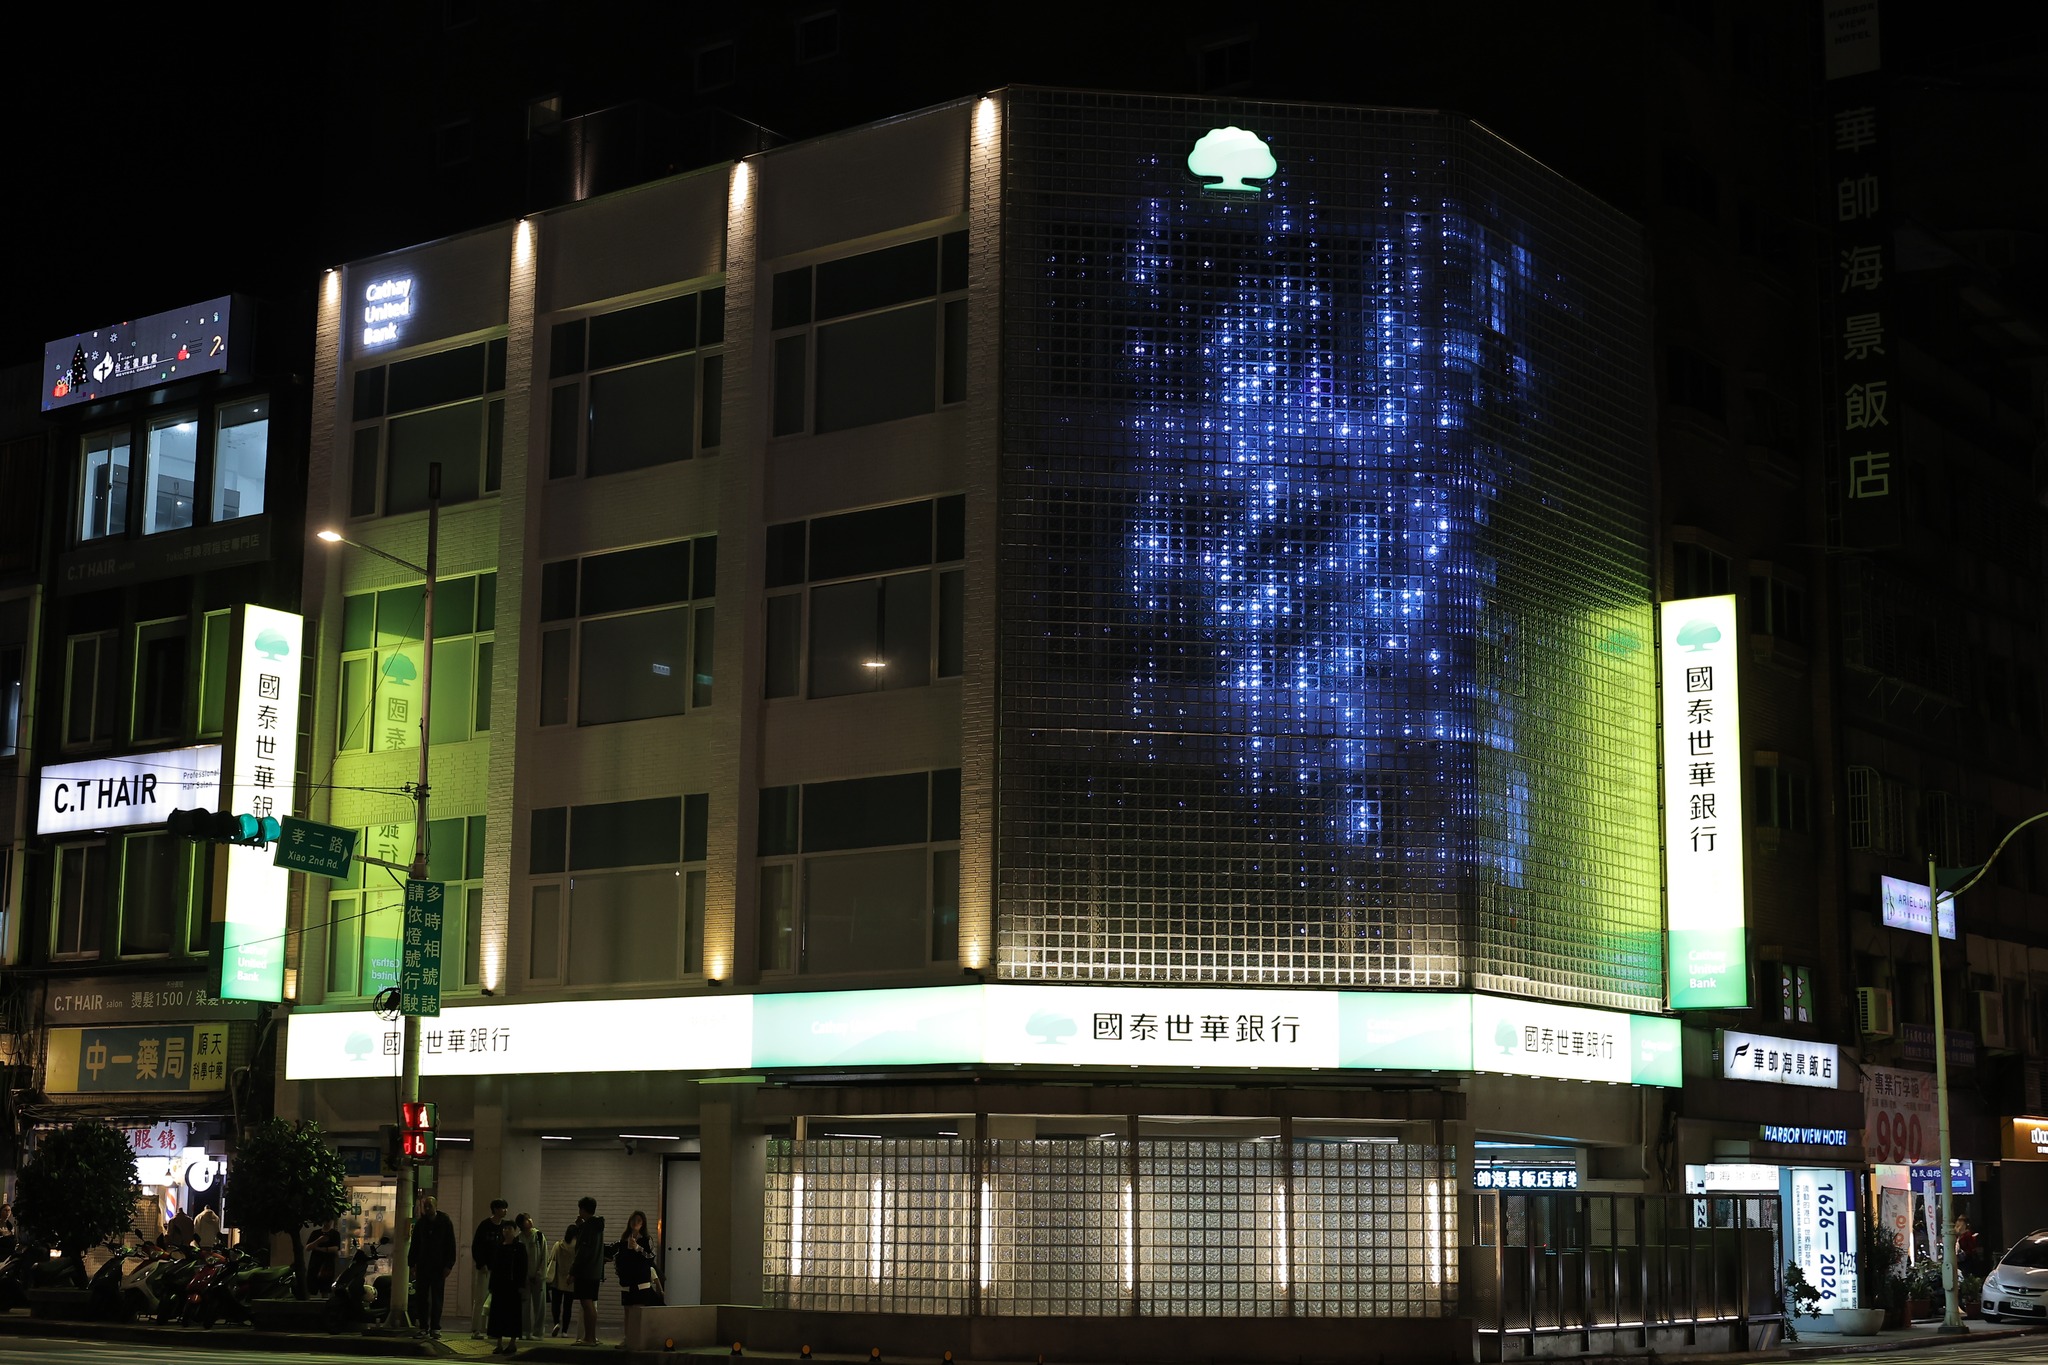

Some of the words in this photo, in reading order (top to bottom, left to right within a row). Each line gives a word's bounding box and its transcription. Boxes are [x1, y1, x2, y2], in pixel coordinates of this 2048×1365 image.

[1829, 3, 1874, 19] HARBOR
[1838, 17, 1866, 30] VIEW
[1834, 31, 1872, 44] HOTEL
[366, 279, 411, 301] Cathay
[365, 297, 409, 323] United
[1834, 106, 1890, 499] 華帥海景飯店
[364, 322, 397, 345] Bank
[88, 559, 116, 577] HAIR
[252, 673, 280, 852] 國泰世華銀
[1686, 666, 1717, 852] 國泰世華銀行
[183, 768, 220, 780] Professional
[54, 780, 91, 813] C.T
[98, 773, 157, 809] HAIR
[292, 828, 344, 853] 孝二路
[288, 851, 306, 862] Xiao
[308, 855, 325, 866] 2nd
[327, 860, 339, 869] Rd.
[403, 883, 425, 1012] 請依燈號行駛
[421, 885, 442, 1012] 多時相號誌
[237, 957, 268, 969] United
[1689, 962, 1726, 974] United
[237, 970, 259, 982] Bank
[1689, 977, 1717, 989] Bank
[54, 995, 72, 1012] C.T
[74, 994, 103, 1011] HAIR
[106, 999, 123, 1008] salon
[1093, 1013, 1301, 1043] 國泰世華銀行
[383, 1027, 511, 1056] 國世華銀行
[1525, 1025, 1614, 1060] 國泰世華銀行
[85, 1037, 186, 1082] 中一藥局
[1754, 1048, 1832, 1079] 華帥海景飯店
[123, 1129, 177, 1151] 眼鏡
[1764, 1125, 1800, 1144] HARBOR
[1801, 1128, 1823, 1145] VIEW
[1823, 1129, 1847, 1146] HOTEL
[1876, 1110, 1922, 1164] 990
[1474, 1170, 1578, 1188] 帥海景飯店新
